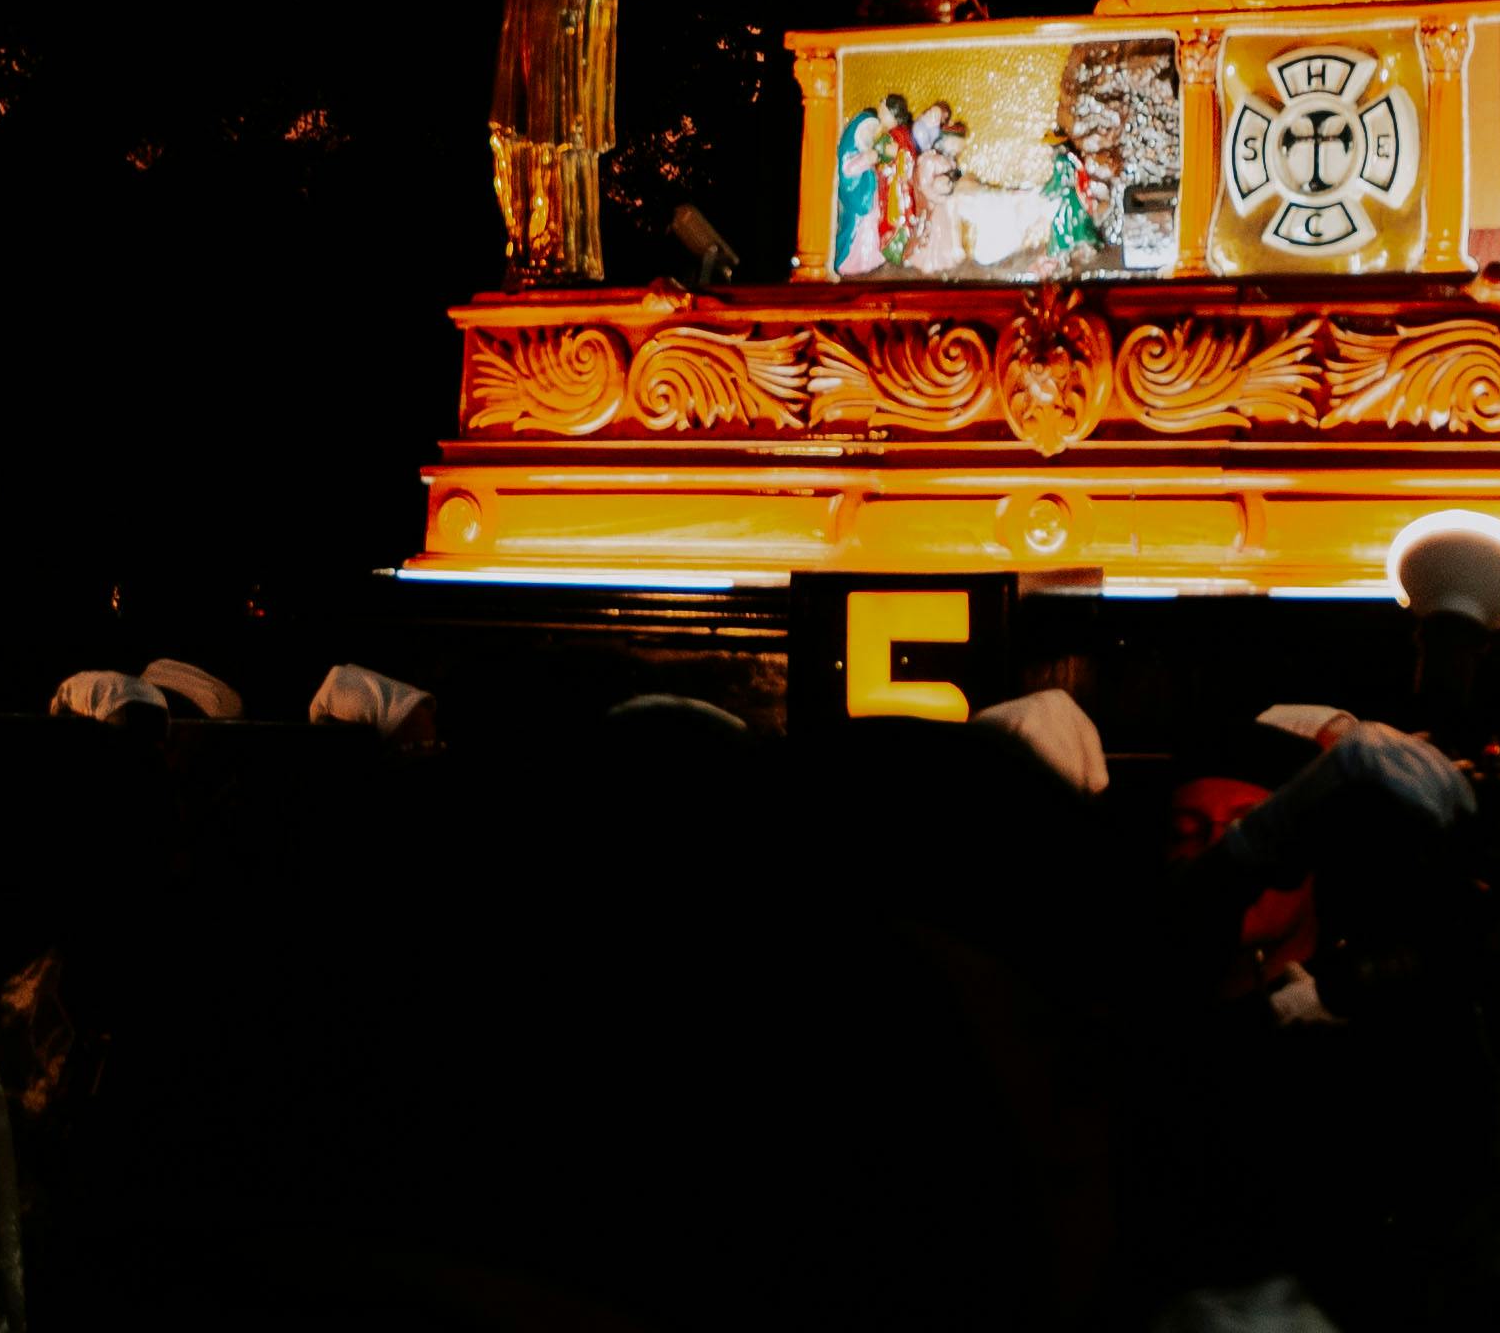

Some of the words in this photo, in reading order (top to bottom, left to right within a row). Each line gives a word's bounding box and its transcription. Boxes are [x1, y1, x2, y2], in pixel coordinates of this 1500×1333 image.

[1306, 62, 1327, 87] H
[1242, 136, 1259, 162] S
[1376, 133, 1391, 160] E
[1304, 212, 1324, 238] C
[847, 591, 970, 723] 5
